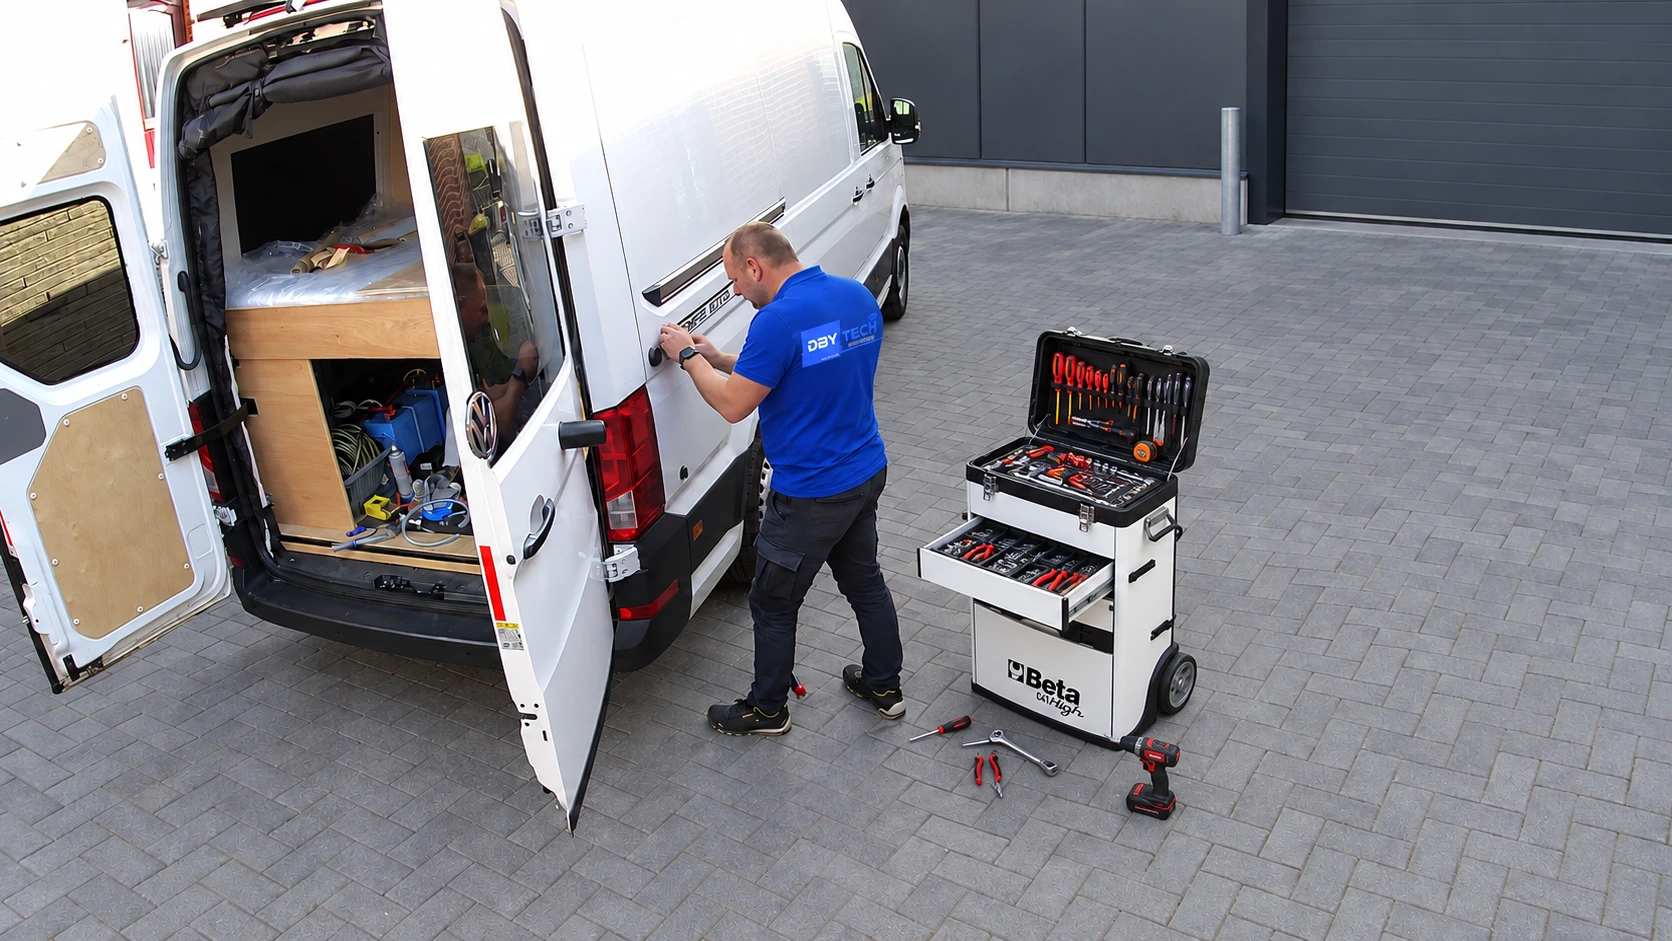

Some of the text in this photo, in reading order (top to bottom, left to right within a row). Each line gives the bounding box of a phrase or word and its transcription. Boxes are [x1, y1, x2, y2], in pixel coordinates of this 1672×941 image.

[807, 332, 838, 353] DBY
[842, 320, 877, 342] TECH
[1026, 666, 1081, 706] Beta
